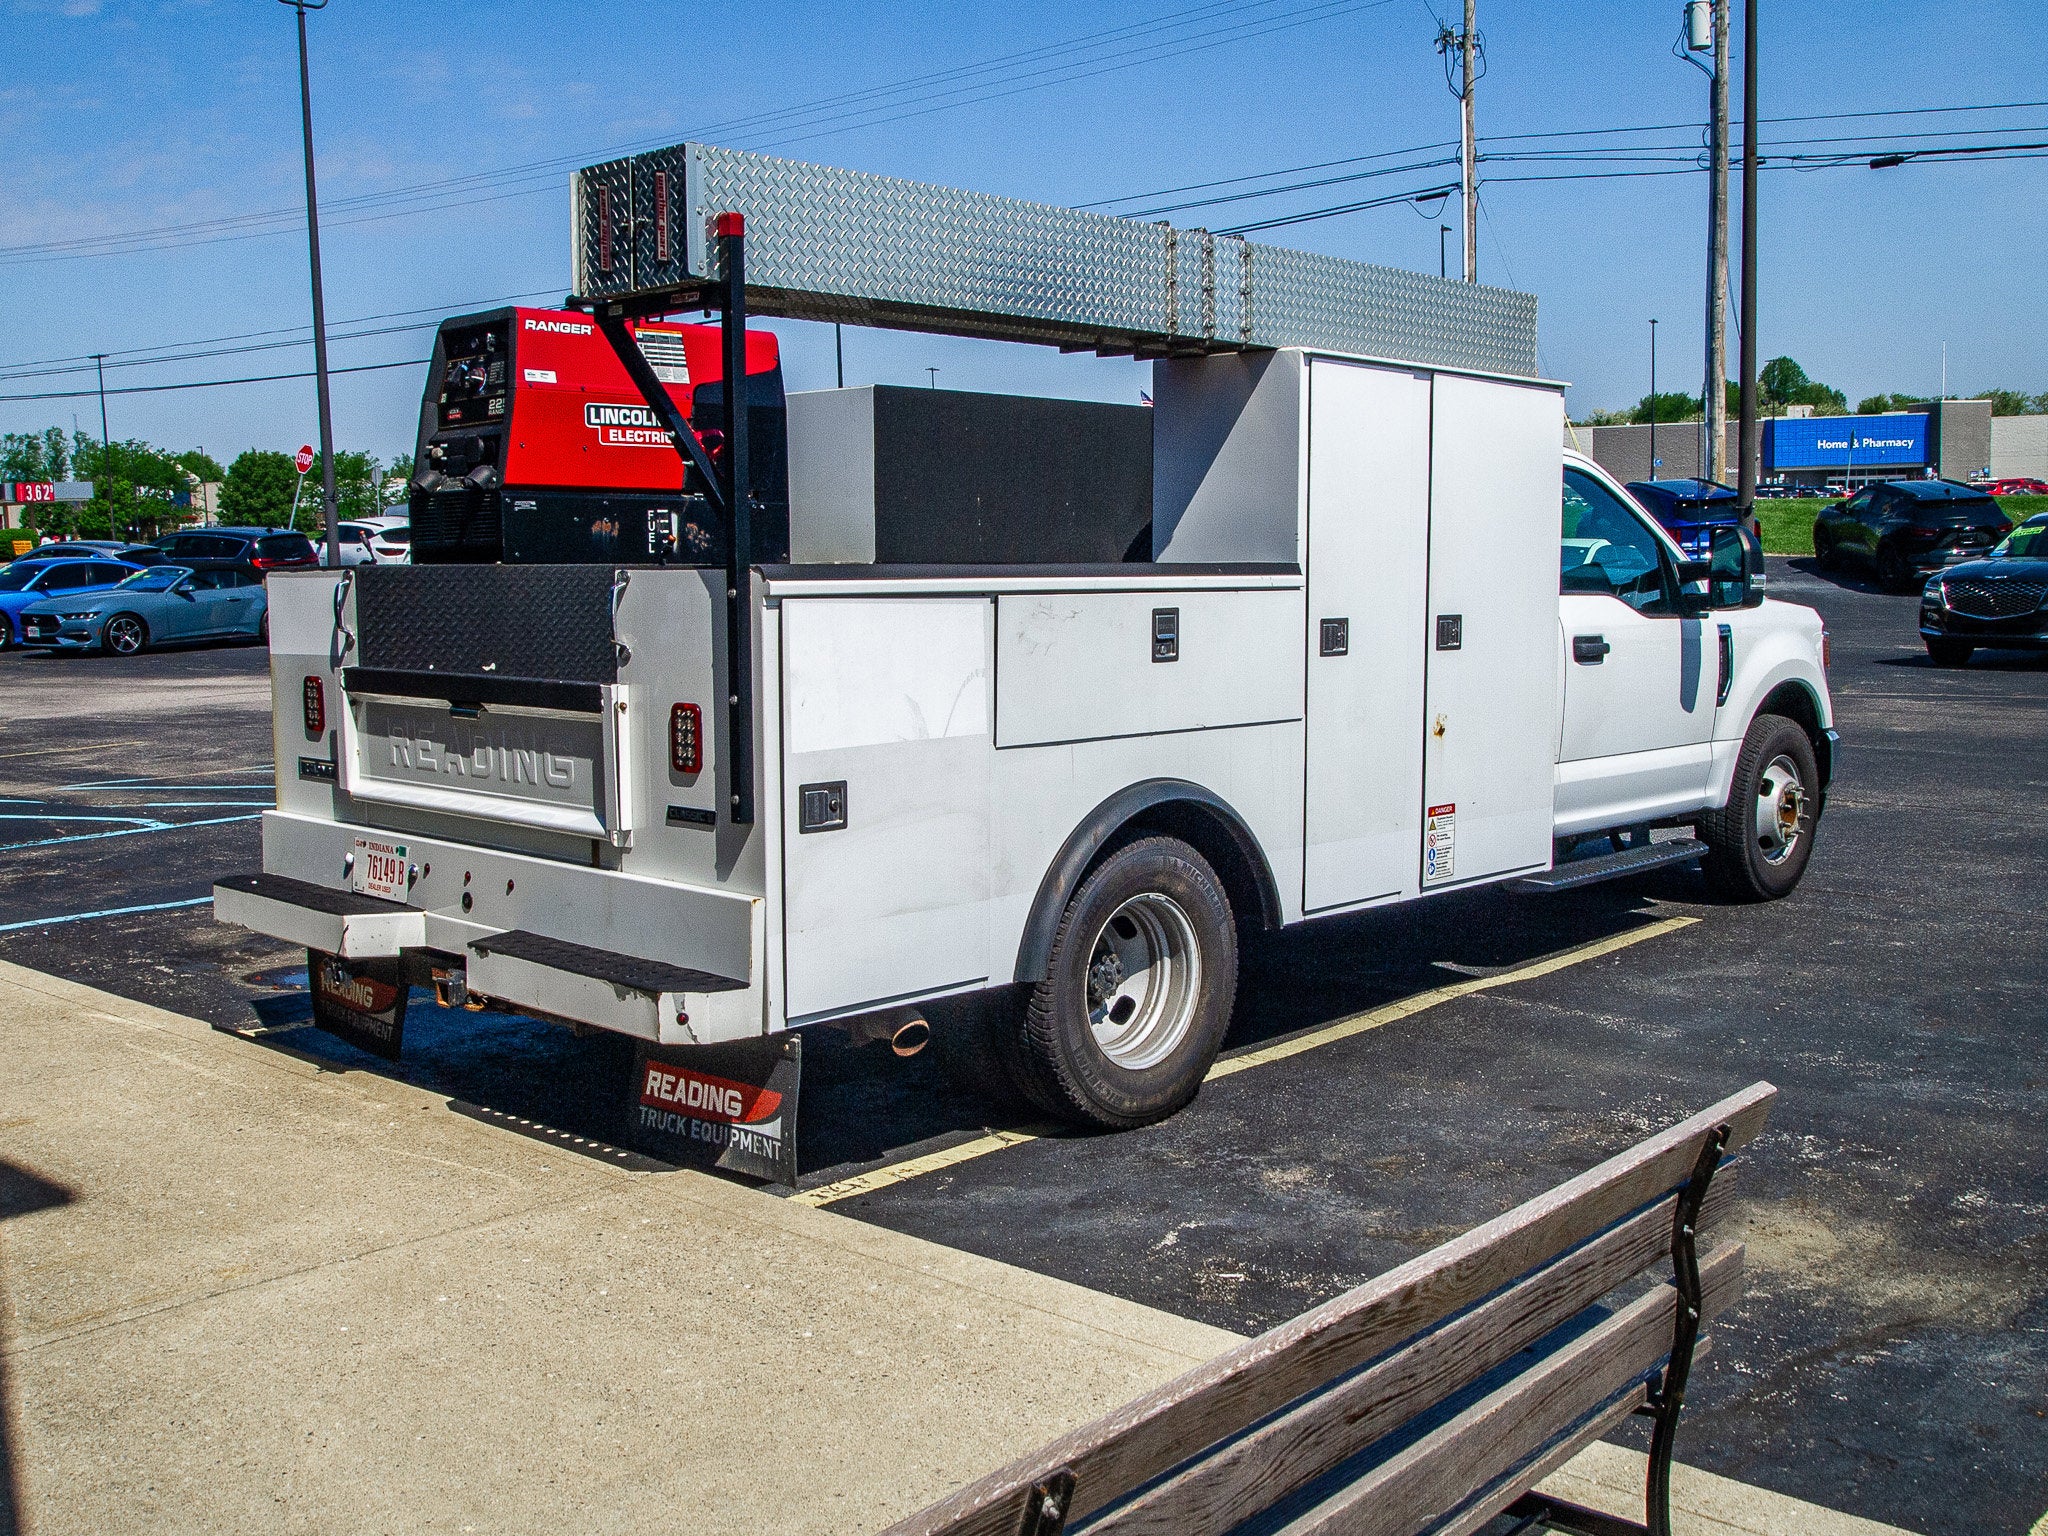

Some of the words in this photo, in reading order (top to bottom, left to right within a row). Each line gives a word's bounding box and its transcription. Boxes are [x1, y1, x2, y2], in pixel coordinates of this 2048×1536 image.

[524, 319, 592, 336] RANGER
[1817, 439, 1848, 450] Home
[1852, 439, 1859, 448] &
[1862, 437, 1914, 451] Pharmacy
[297, 452, 313, 466] STOP
[647, 509, 656, 554] FUEL
[388, 718, 575, 790] READING
[1435, 806, 1453, 815] DANGER
[368, 841, 394, 855] INDIANA
[367, 853, 396, 883] 76149
[397, 860, 405, 886] B
[368, 882, 382, 892] DEALER
[347, 1009, 394, 1042] EQUIPMENT
[645, 1069, 742, 1117] READING
[639, 1106, 688, 1137] TRUCK
[691, 1119, 782, 1161] EQUIPMENT
